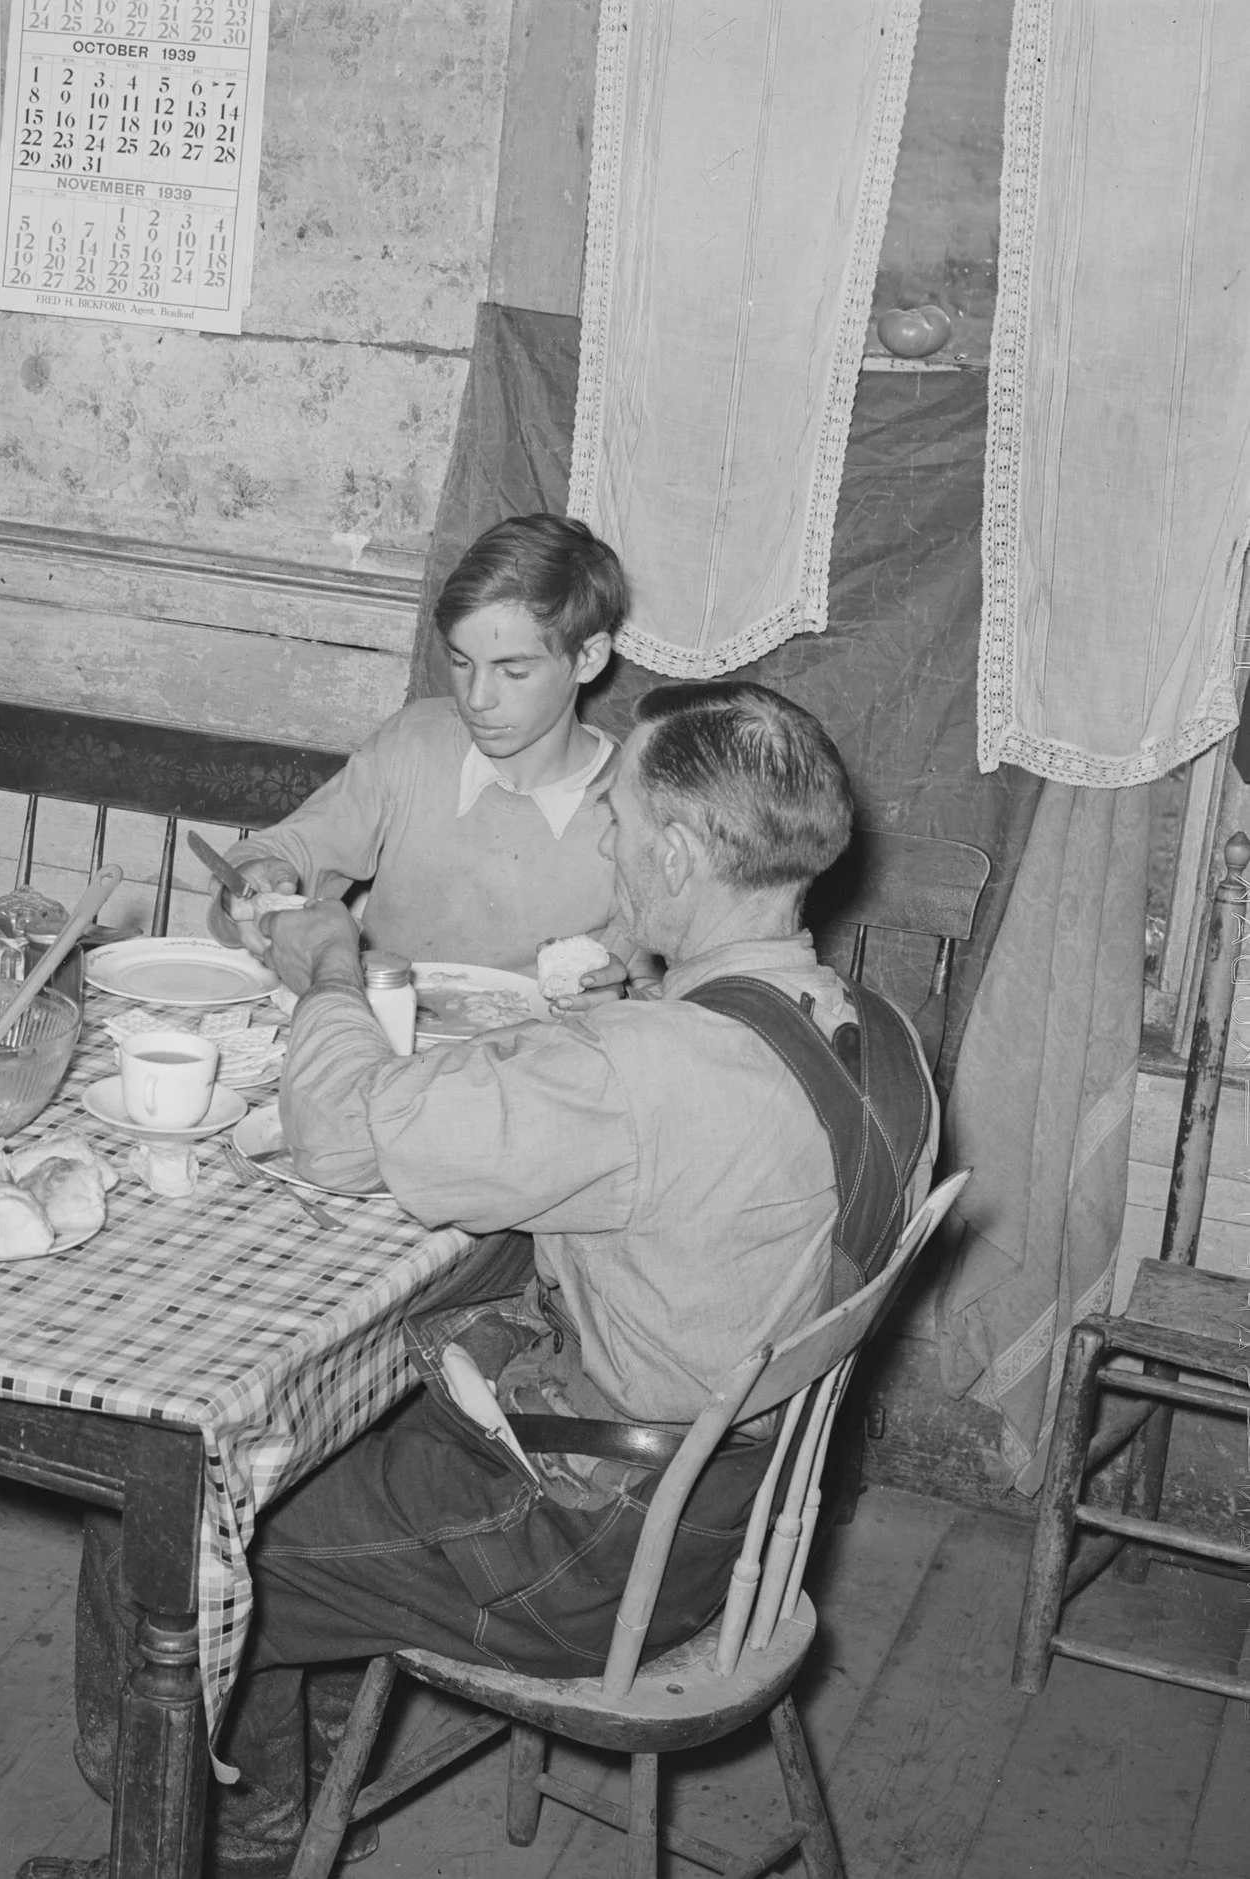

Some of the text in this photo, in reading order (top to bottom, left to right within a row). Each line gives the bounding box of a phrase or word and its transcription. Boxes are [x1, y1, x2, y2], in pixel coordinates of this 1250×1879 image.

[73, 41, 196, 62] OCTOBER 1939
[32, 66, 236, 99] 1 2 3 4 5 6 7
[30, 88, 239, 120] 8 9 10 11 12 13 14
[24, 108, 235, 142] 15 16 17 18 19 20 21
[20, 129, 235, 164] 22 23 24 25 26 27 28
[20, 150, 102, 173] 29 30 31
[58, 178, 192, 200] NOVEMBER 1939
[20, 216, 226, 251] 5 6 7 8 9 10 11
[119, 207, 224, 232] 1 2 3 4
[16, 233, 227, 269] 12 13 14 15 16 17 18
[10, 268, 159, 299] 26 27 28 29 30
[13, 250, 225, 287] 19 20 21 22 23 24 25
[36, 296, 60, 306] FRED
[161, 307, 194, 319] Bradford
